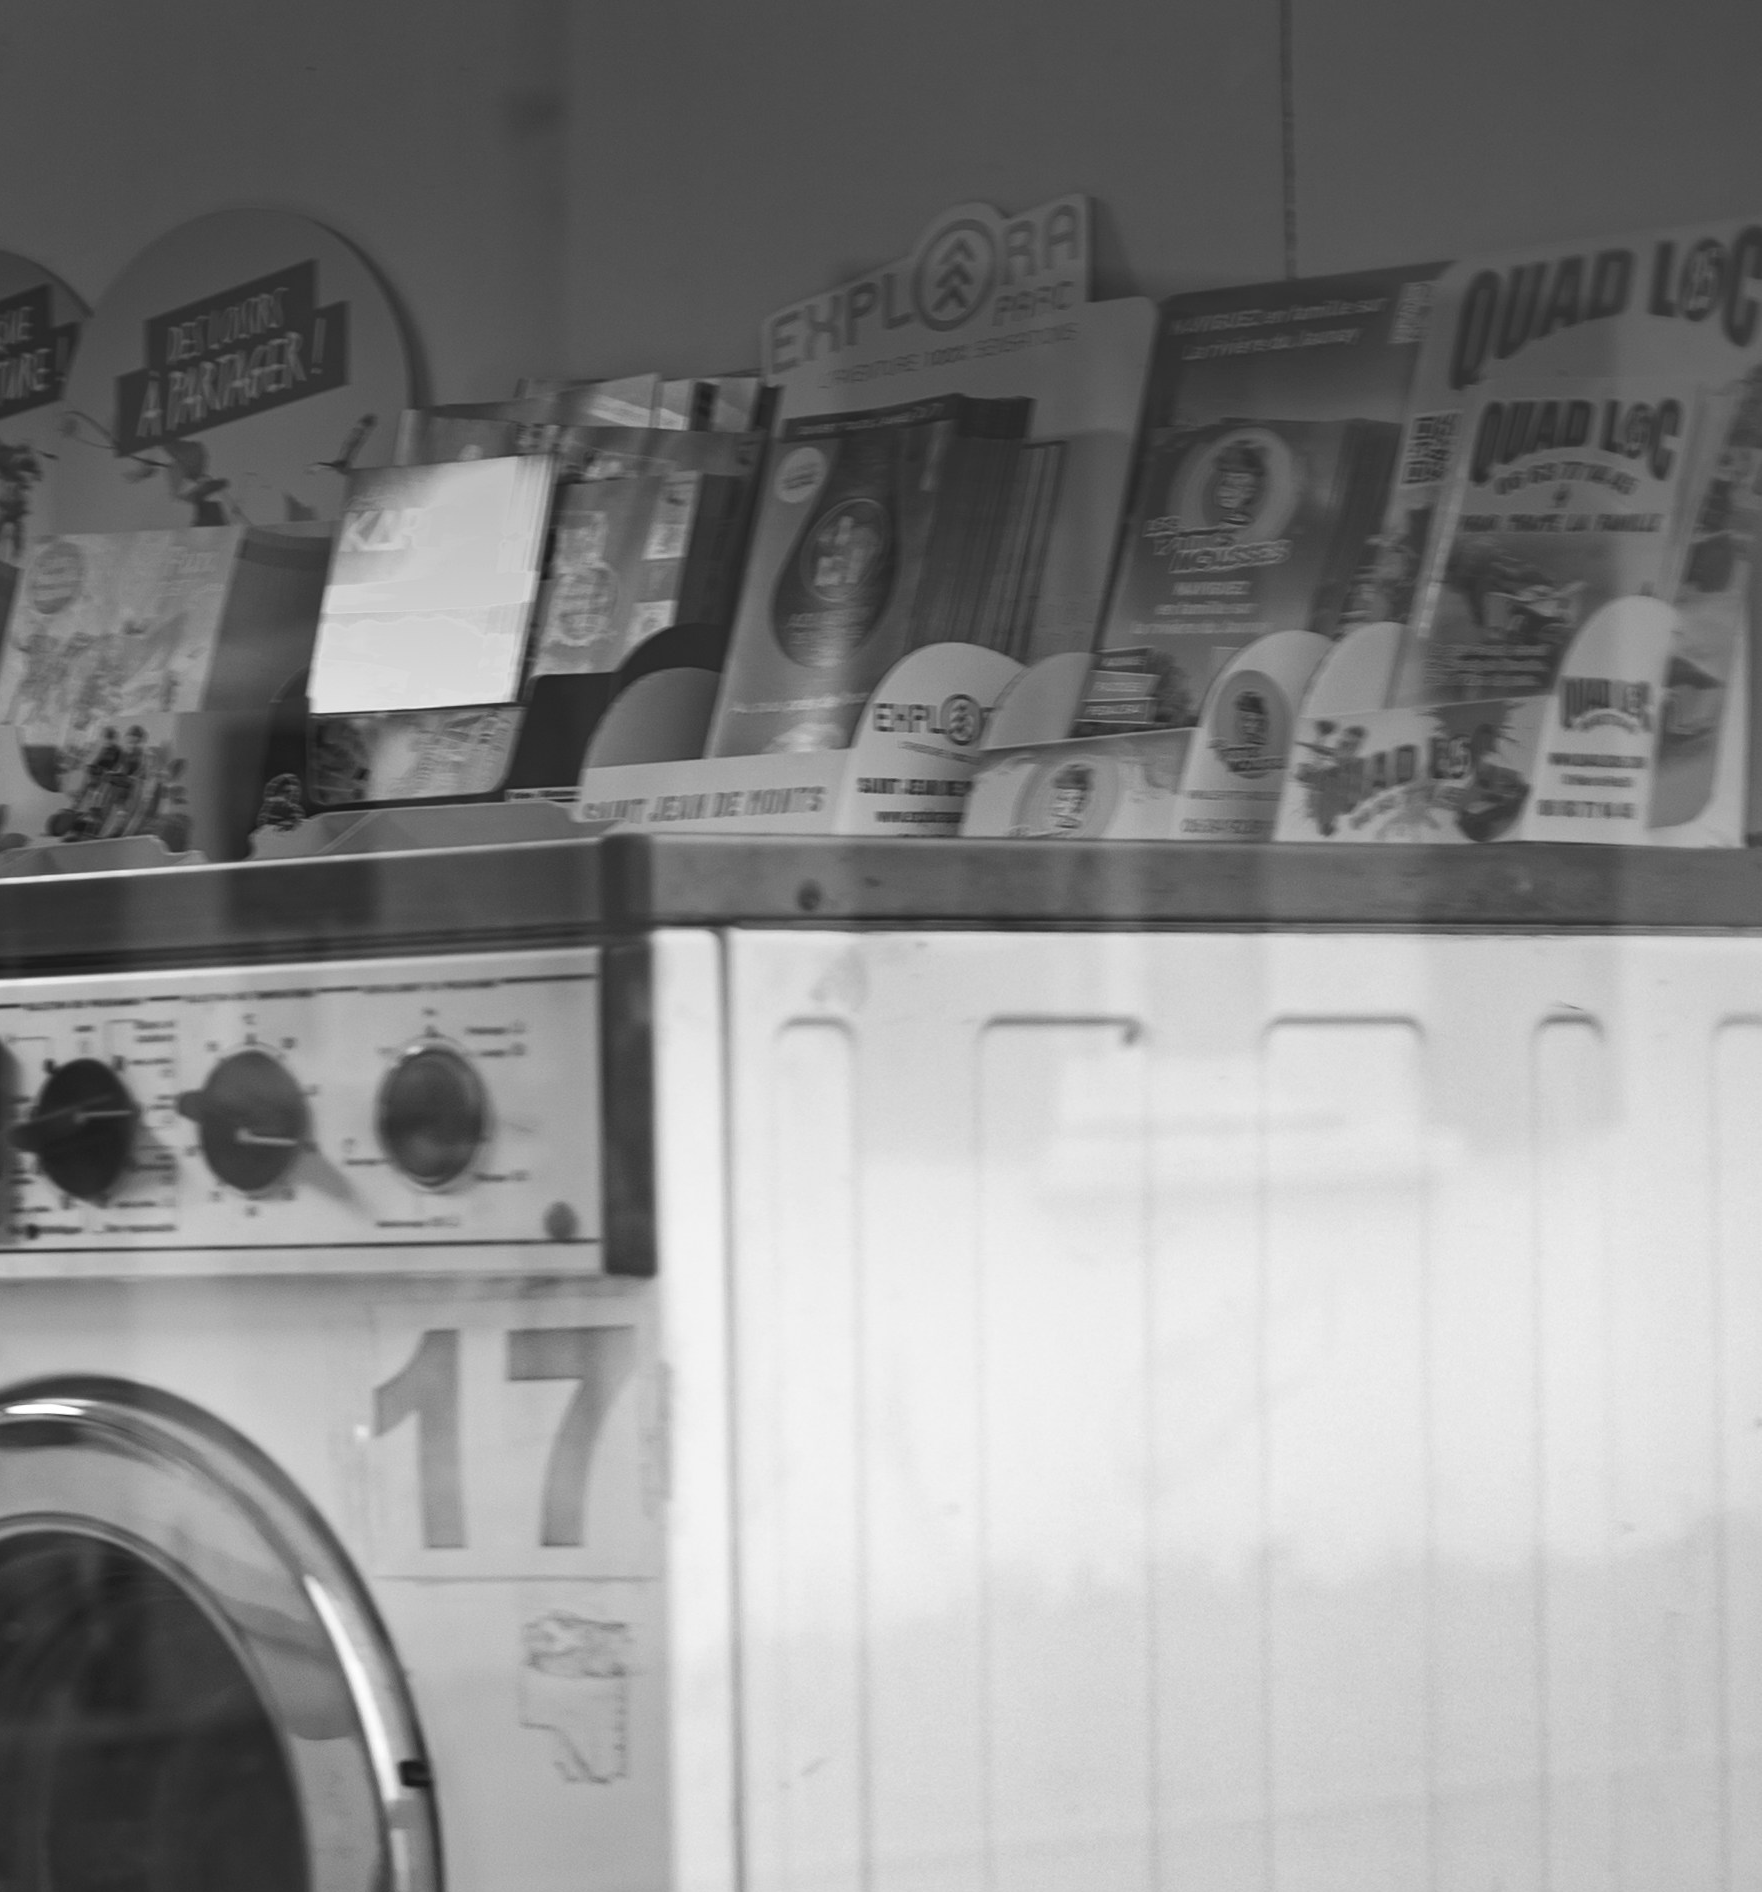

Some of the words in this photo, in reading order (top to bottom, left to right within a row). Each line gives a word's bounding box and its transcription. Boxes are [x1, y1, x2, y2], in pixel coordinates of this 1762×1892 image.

[1449, 247, 1637, 391] QUAD
[1469, 402, 1593, 487] QUAD
[373, 1323, 637, 1549] 17
